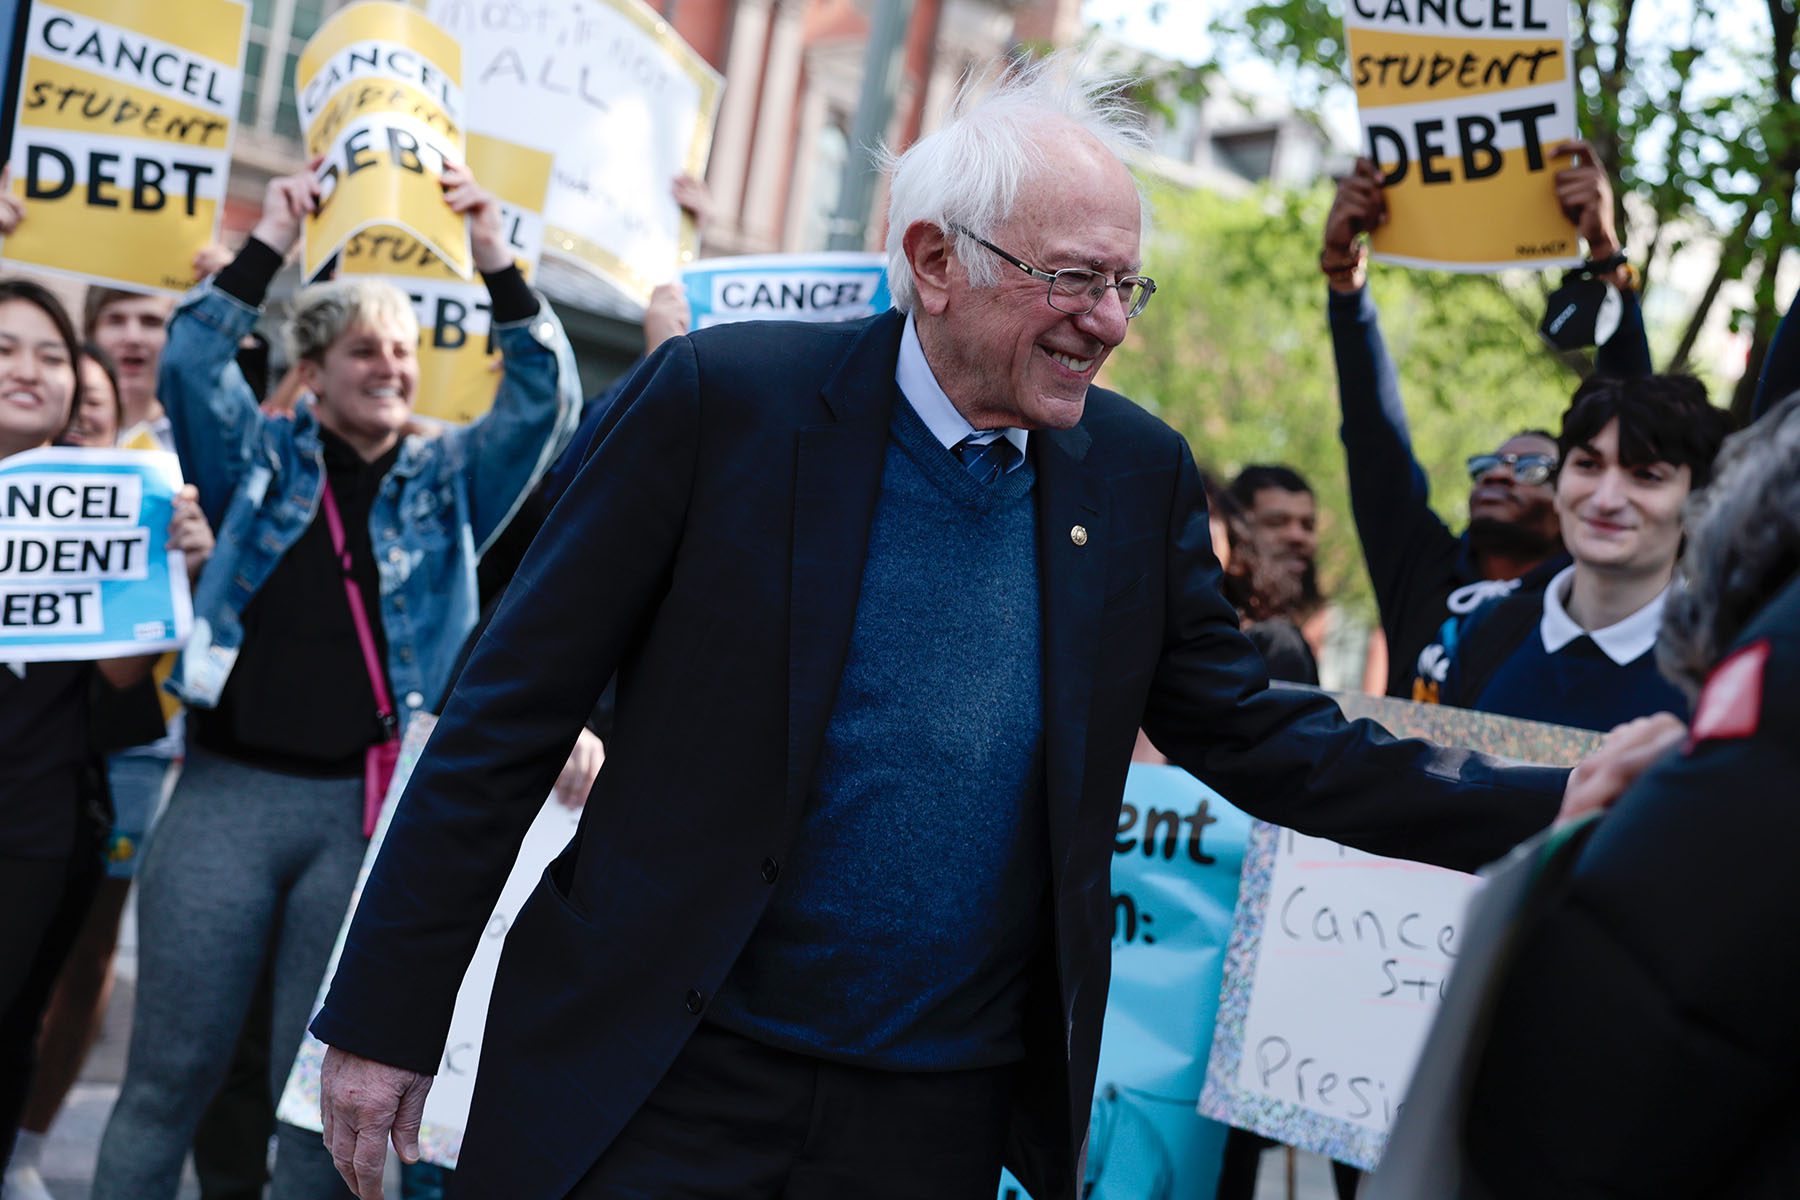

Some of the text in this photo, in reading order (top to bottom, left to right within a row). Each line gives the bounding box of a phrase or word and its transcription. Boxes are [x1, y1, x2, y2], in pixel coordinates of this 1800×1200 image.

[1354, 0, 1548, 31] CANCEL
[42, 17, 223, 106] CANCEL
[305, 48, 461, 114] CANCEL
[478, 47, 608, 113] ALL
[1356, 48, 1558, 88] STUDENT
[27, 82, 224, 143] STUDENT
[1367, 103, 1556, 188] DEBT
[25, 145, 212, 216] DEBT
[0, 484, 130, 519] NCEL
[1113, 799, 1218, 866] ent
